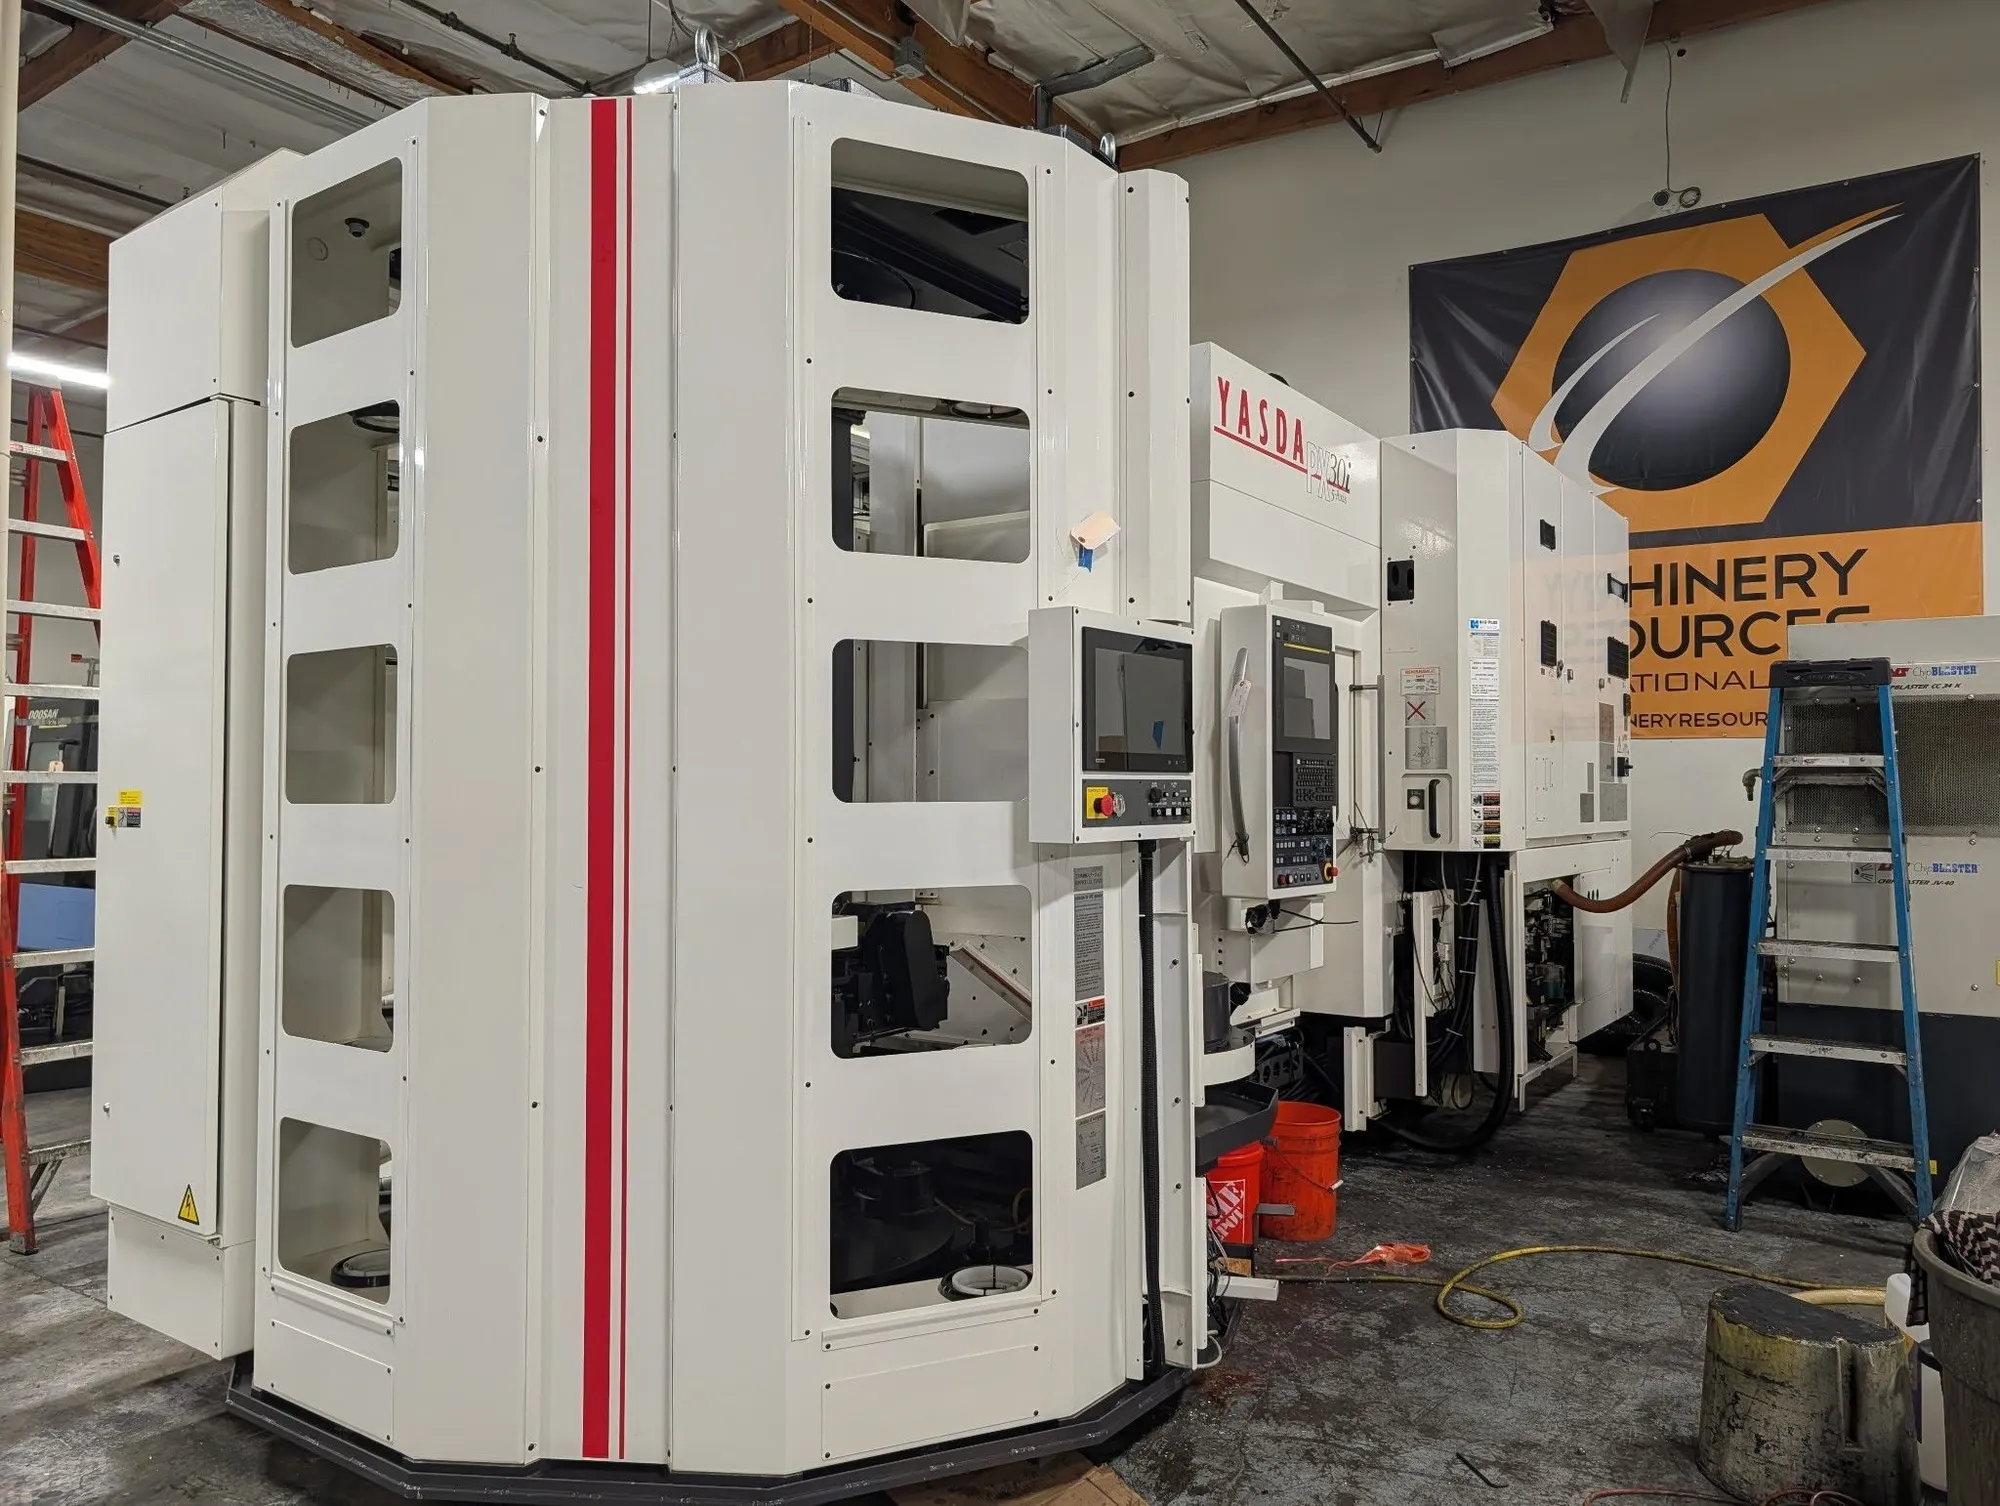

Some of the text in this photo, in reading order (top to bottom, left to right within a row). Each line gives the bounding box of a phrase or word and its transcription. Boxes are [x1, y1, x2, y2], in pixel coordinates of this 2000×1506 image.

[1217, 375, 1304, 465] YASDA
[1629, 548, 1869, 608] HINERY
[1630, 670, 1770, 692] TIONAL
[29, 708, 60, 719] DOOSAN
